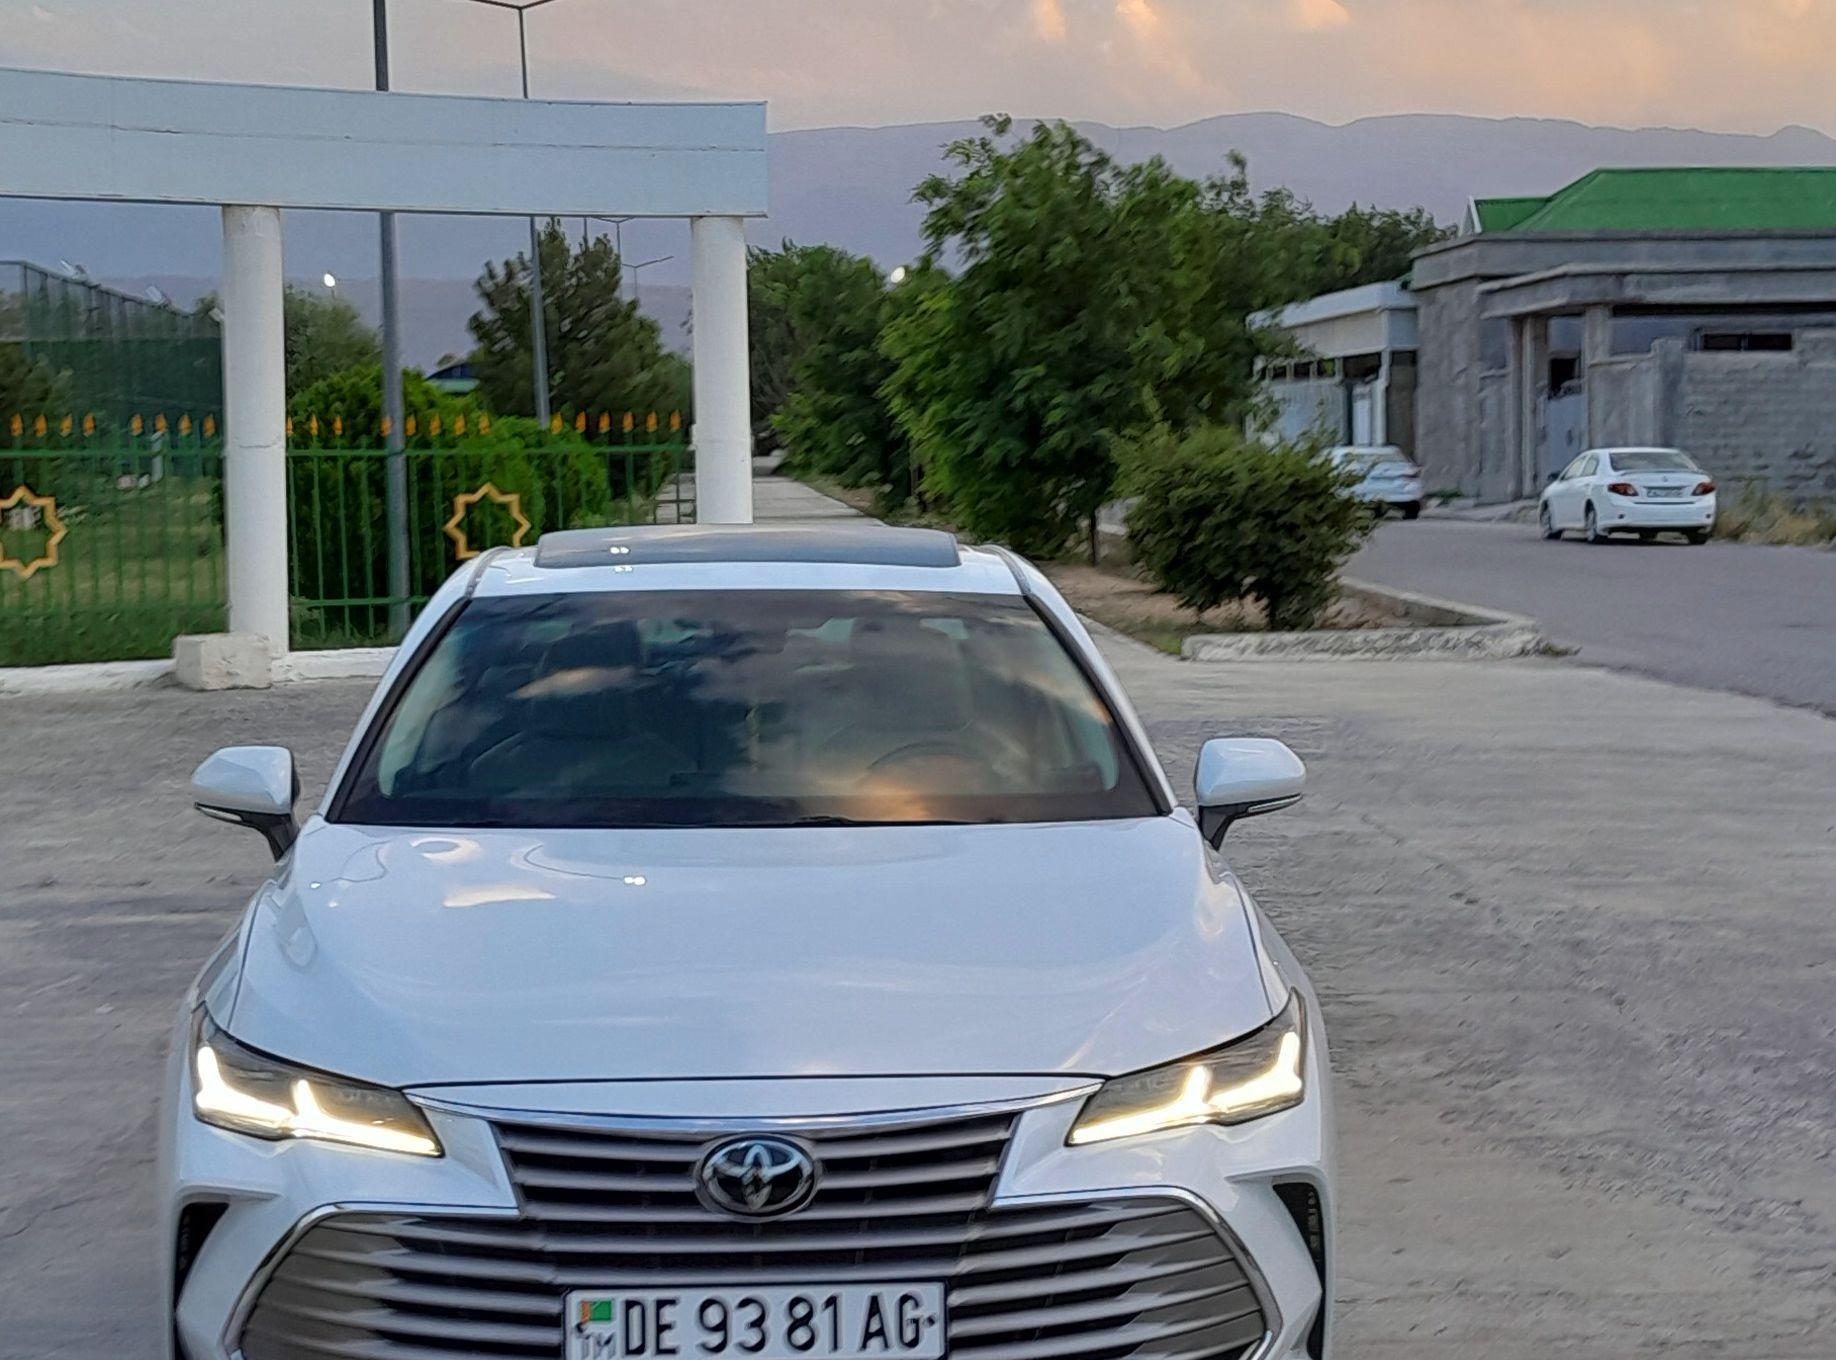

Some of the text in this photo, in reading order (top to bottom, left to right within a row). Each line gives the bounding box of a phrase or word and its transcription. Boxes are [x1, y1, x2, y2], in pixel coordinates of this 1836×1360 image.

[624, 1298, 679, 1355] DE
[696, 1297, 766, 1353] 93
[786, 1295, 839, 1352] 81
[859, 1293, 920, 1351] AG
